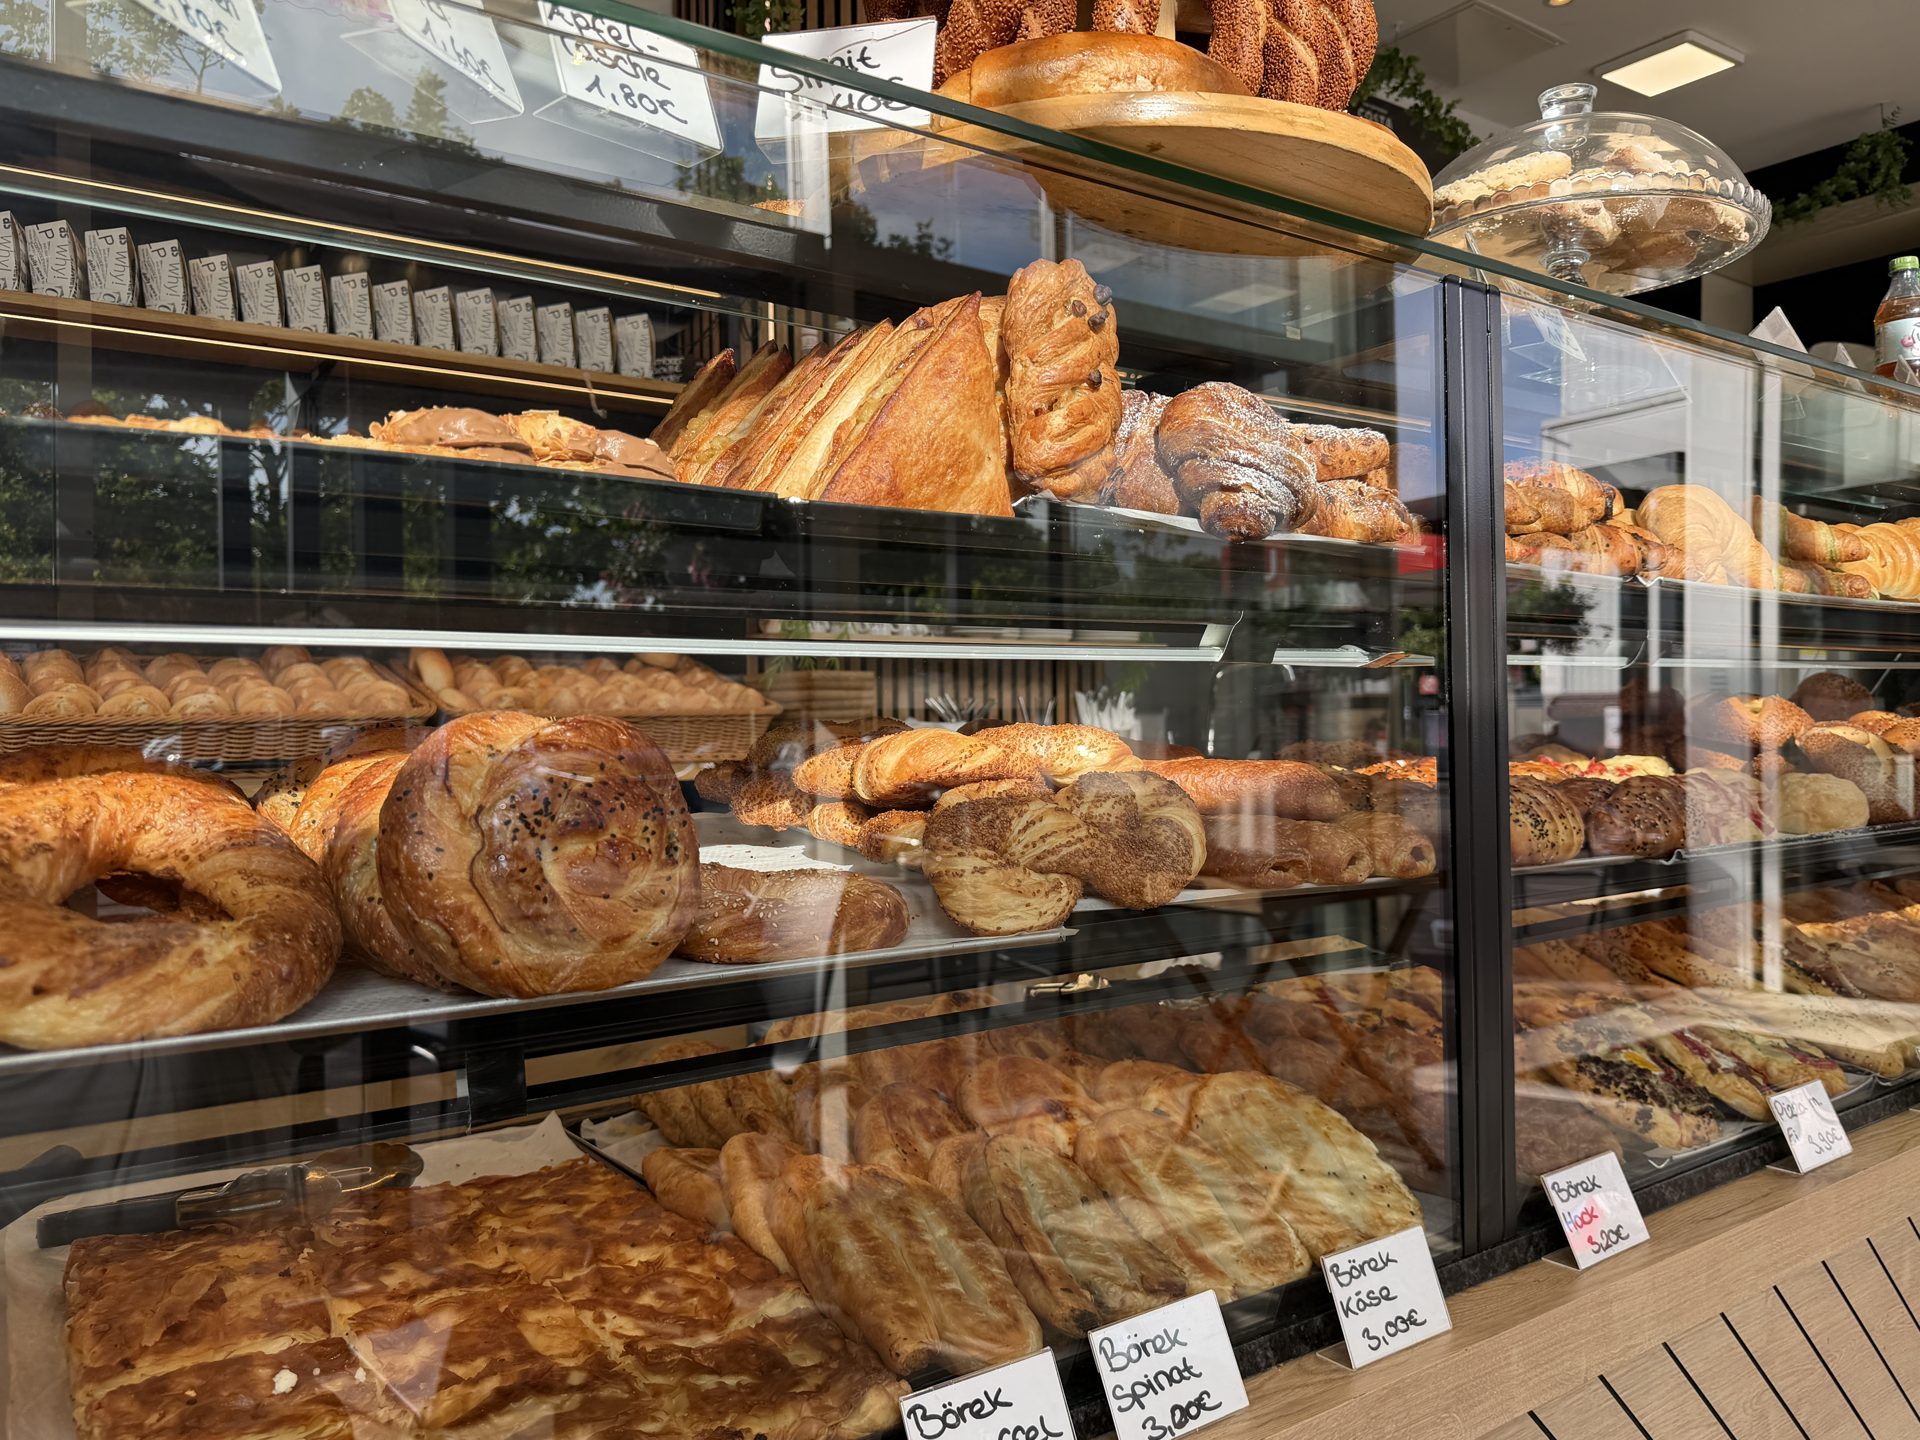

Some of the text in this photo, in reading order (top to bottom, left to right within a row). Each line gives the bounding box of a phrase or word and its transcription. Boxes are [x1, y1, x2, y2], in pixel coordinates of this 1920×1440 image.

[585, 74, 689, 125] 1,80€
[1551, 1174, 1602, 1203] Börek
[1587, 1223, 1630, 1254] 3,20€
[1330, 1251, 1398, 1288] Börek
[1099, 1328, 1188, 1373] Börek
[1362, 1308, 1427, 1351] 3,00€
[906, 1387, 1014, 1440] Börek
